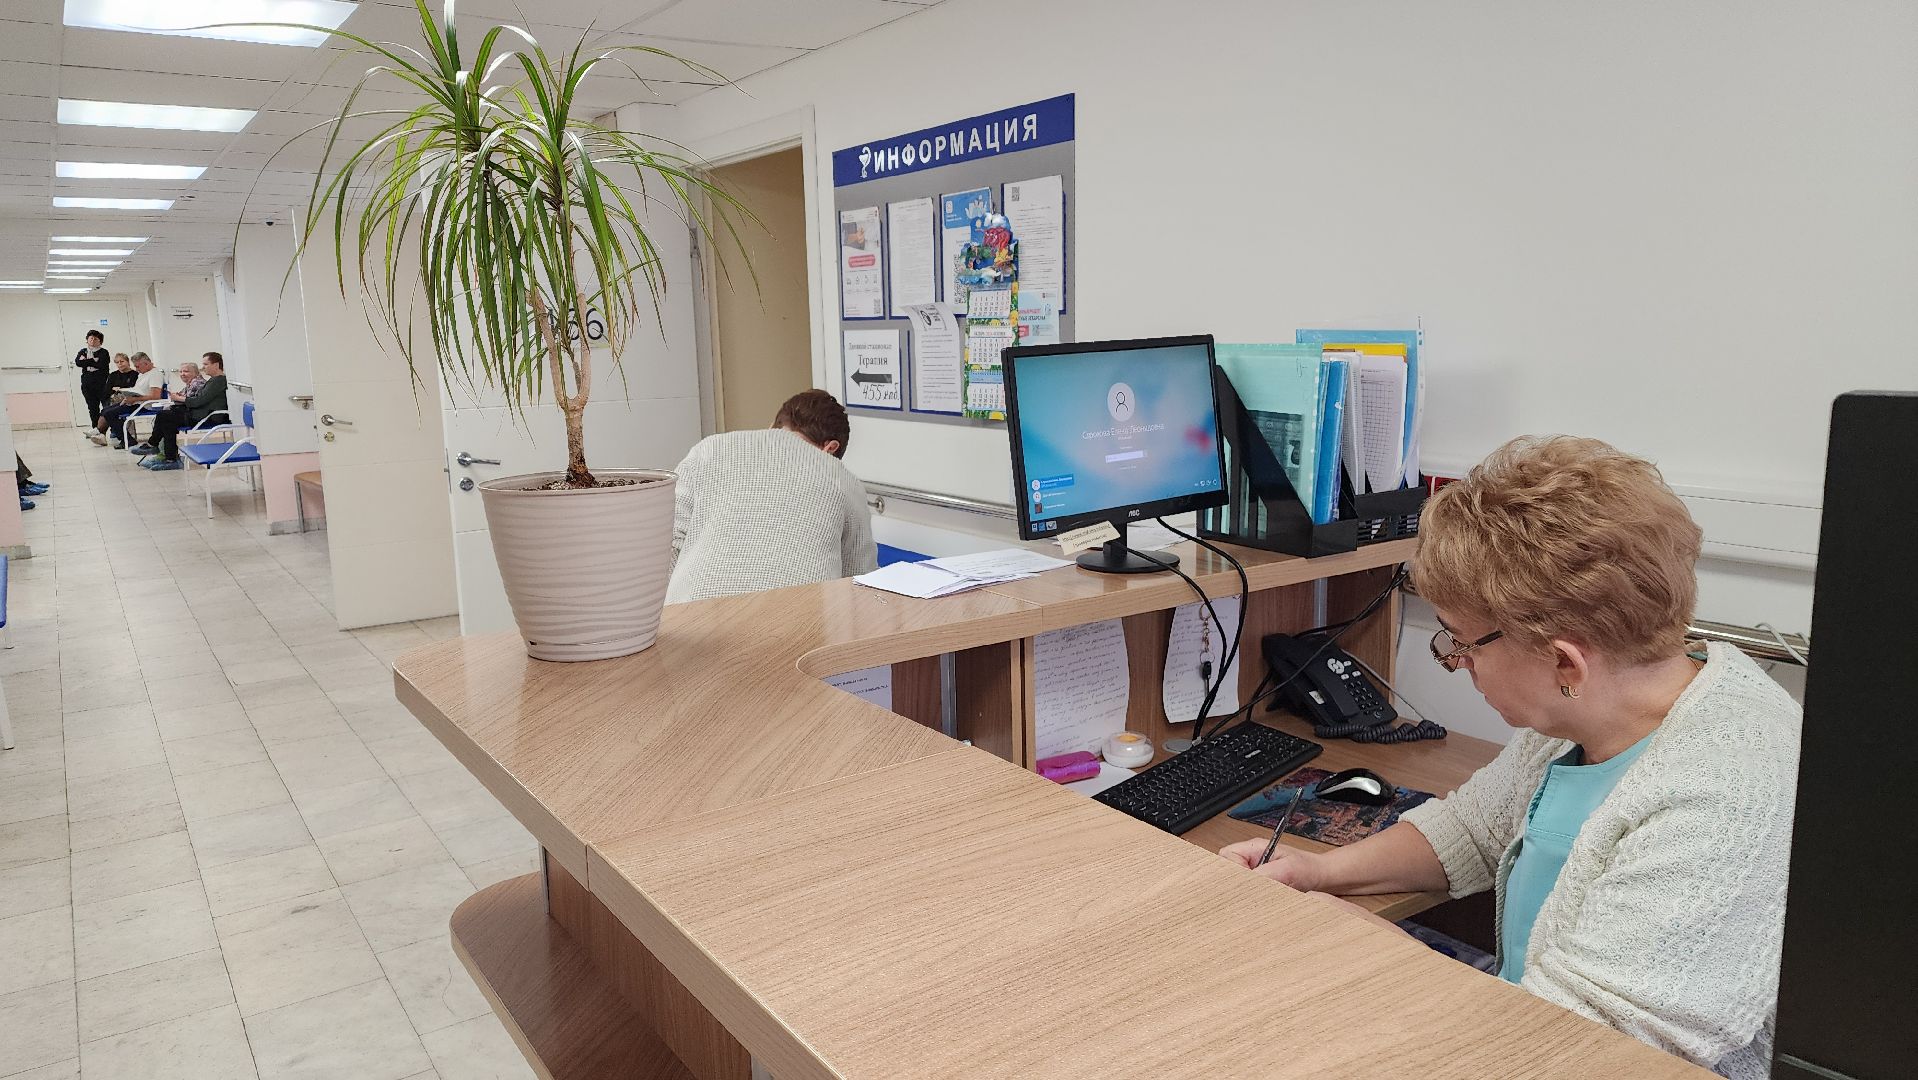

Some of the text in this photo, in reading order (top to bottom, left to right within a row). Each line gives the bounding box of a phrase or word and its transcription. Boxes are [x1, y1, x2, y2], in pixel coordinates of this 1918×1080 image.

[873, 113, 1038, 174] ИНФОРМАЦИЯ
[858, 354, 888, 368] Терапия
[863, 383, 884, 401] 455
